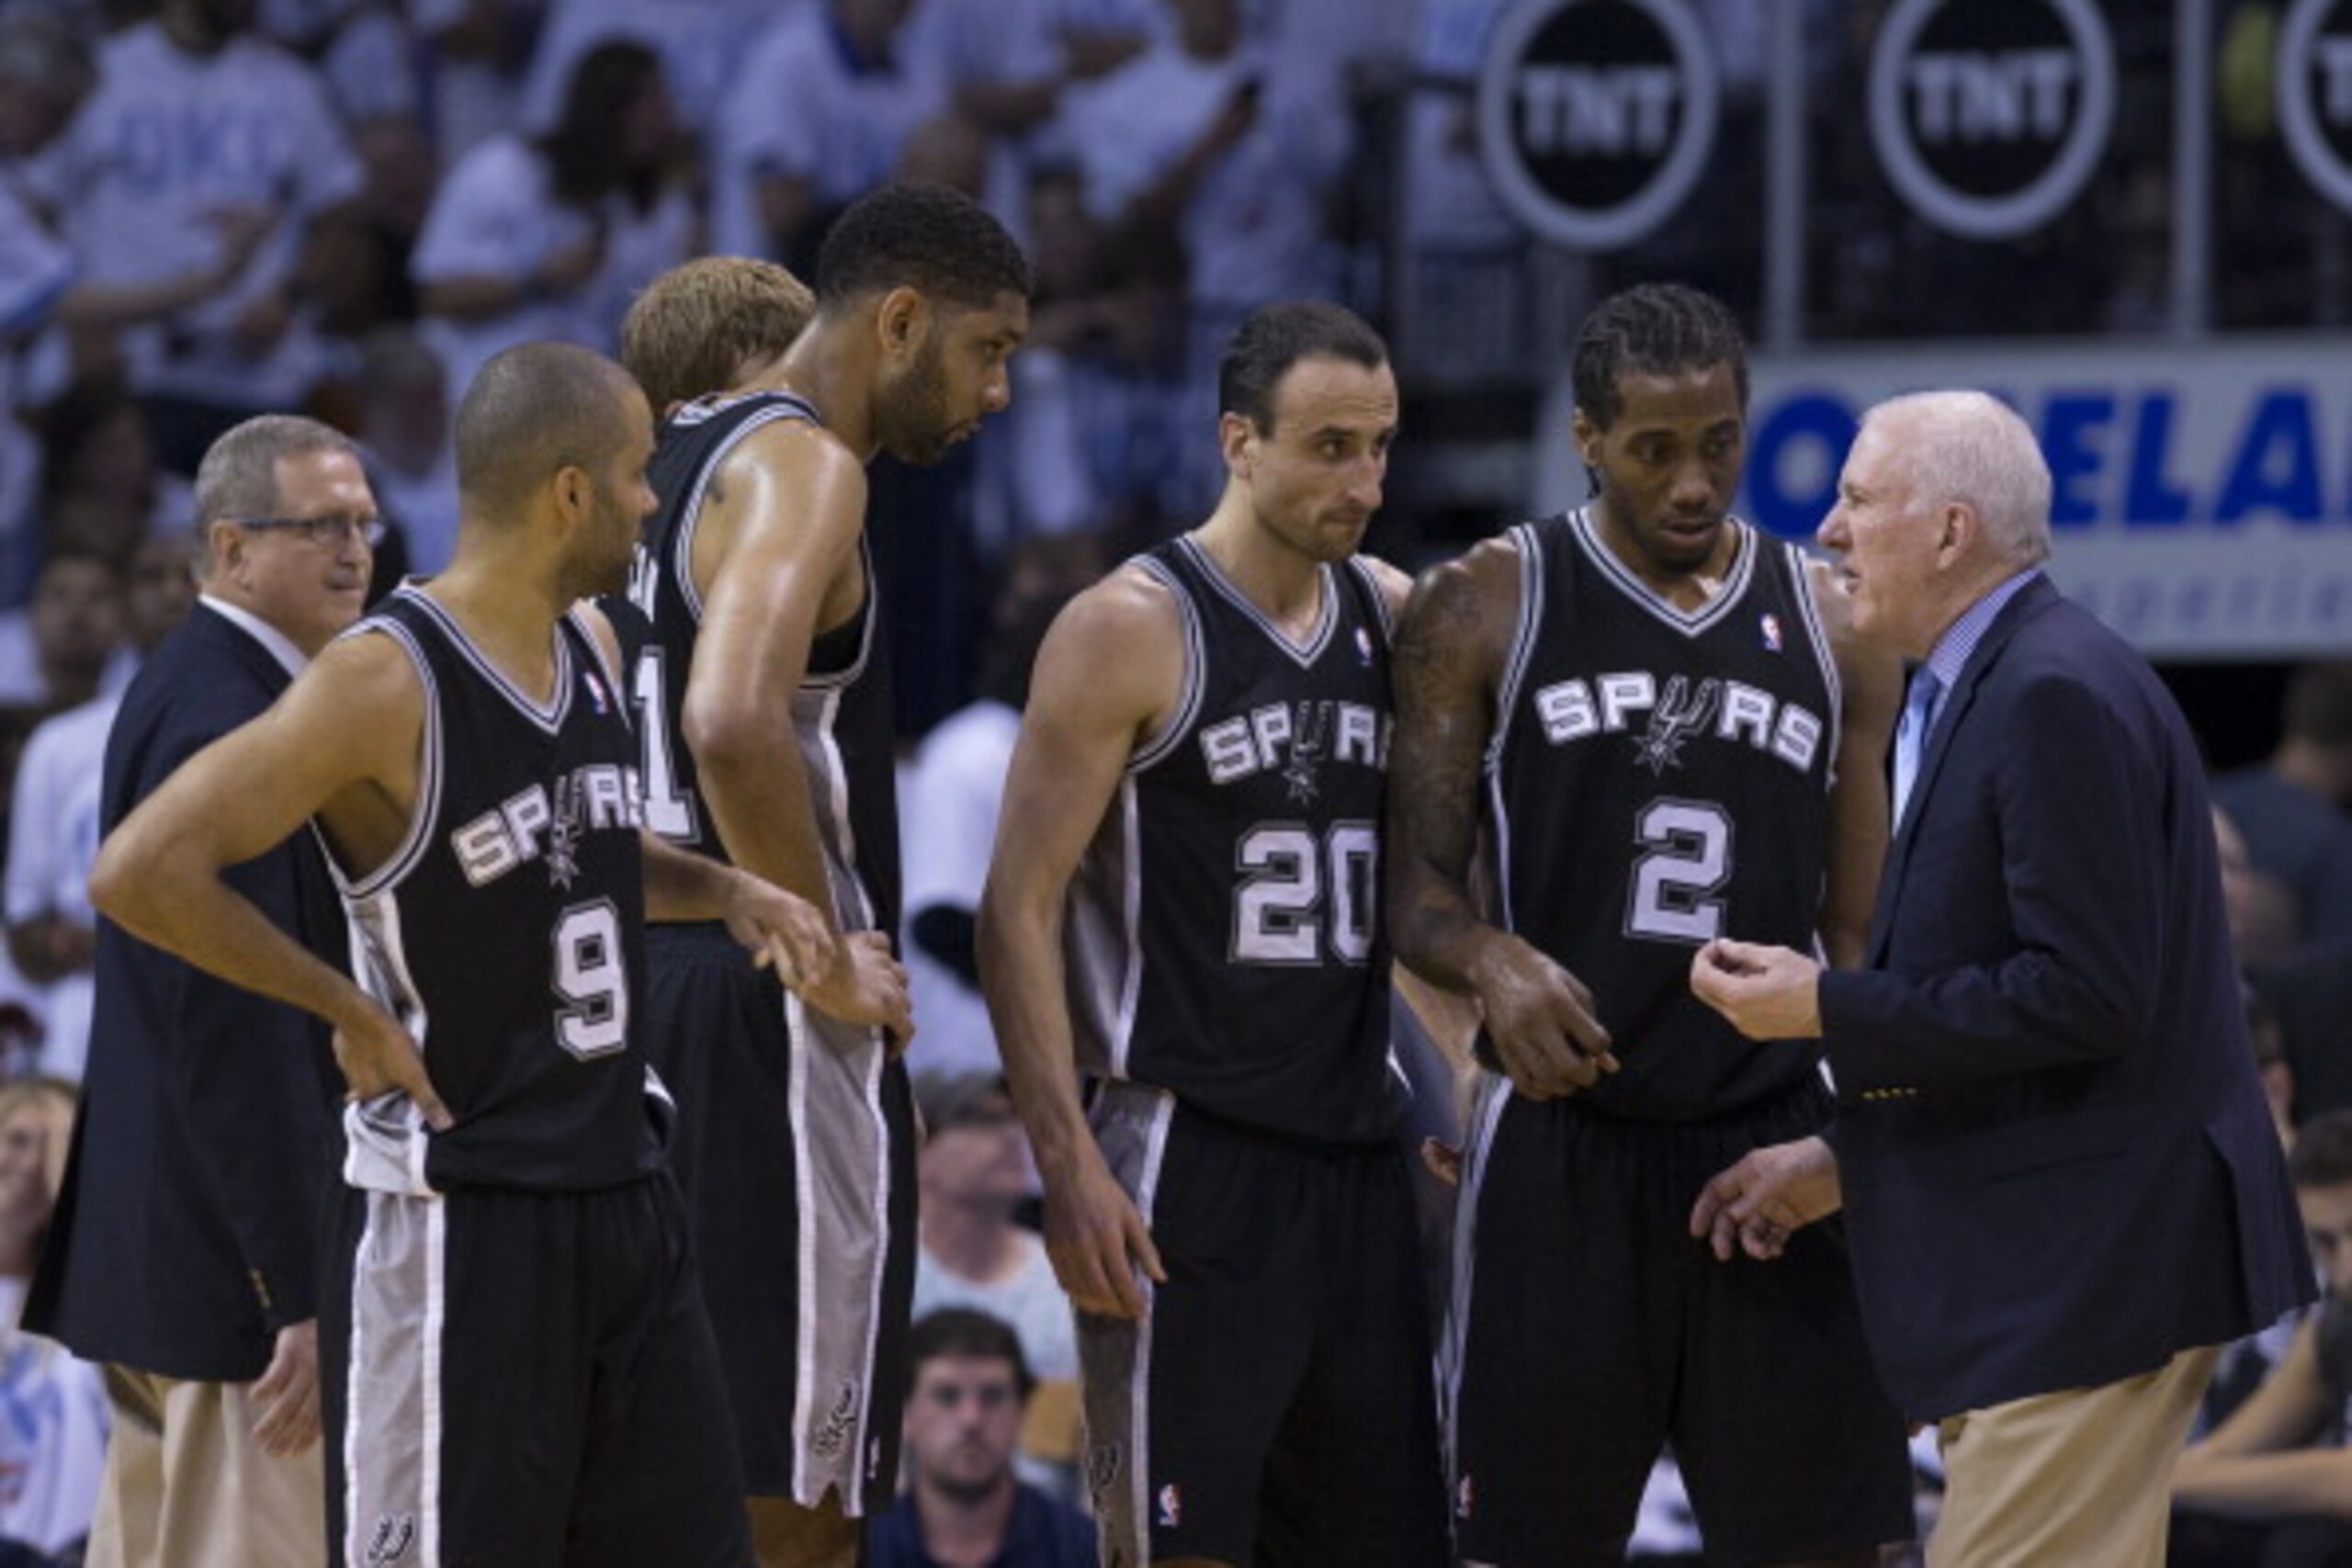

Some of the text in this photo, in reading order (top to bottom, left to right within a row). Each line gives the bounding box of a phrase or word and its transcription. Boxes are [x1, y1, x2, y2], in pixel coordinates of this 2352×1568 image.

[1521, 65, 1674, 152] TNT
[1914, 51, 2073, 142] TNT
[1748, 388, 2352, 542] OELA
[1200, 701, 1394, 805] SPUR
[1535, 671, 1822, 776] SPURS
[1228, 819, 1379, 966] 20
[1623, 795, 1734, 943] 2
[551, 896, 629, 1061] 9
